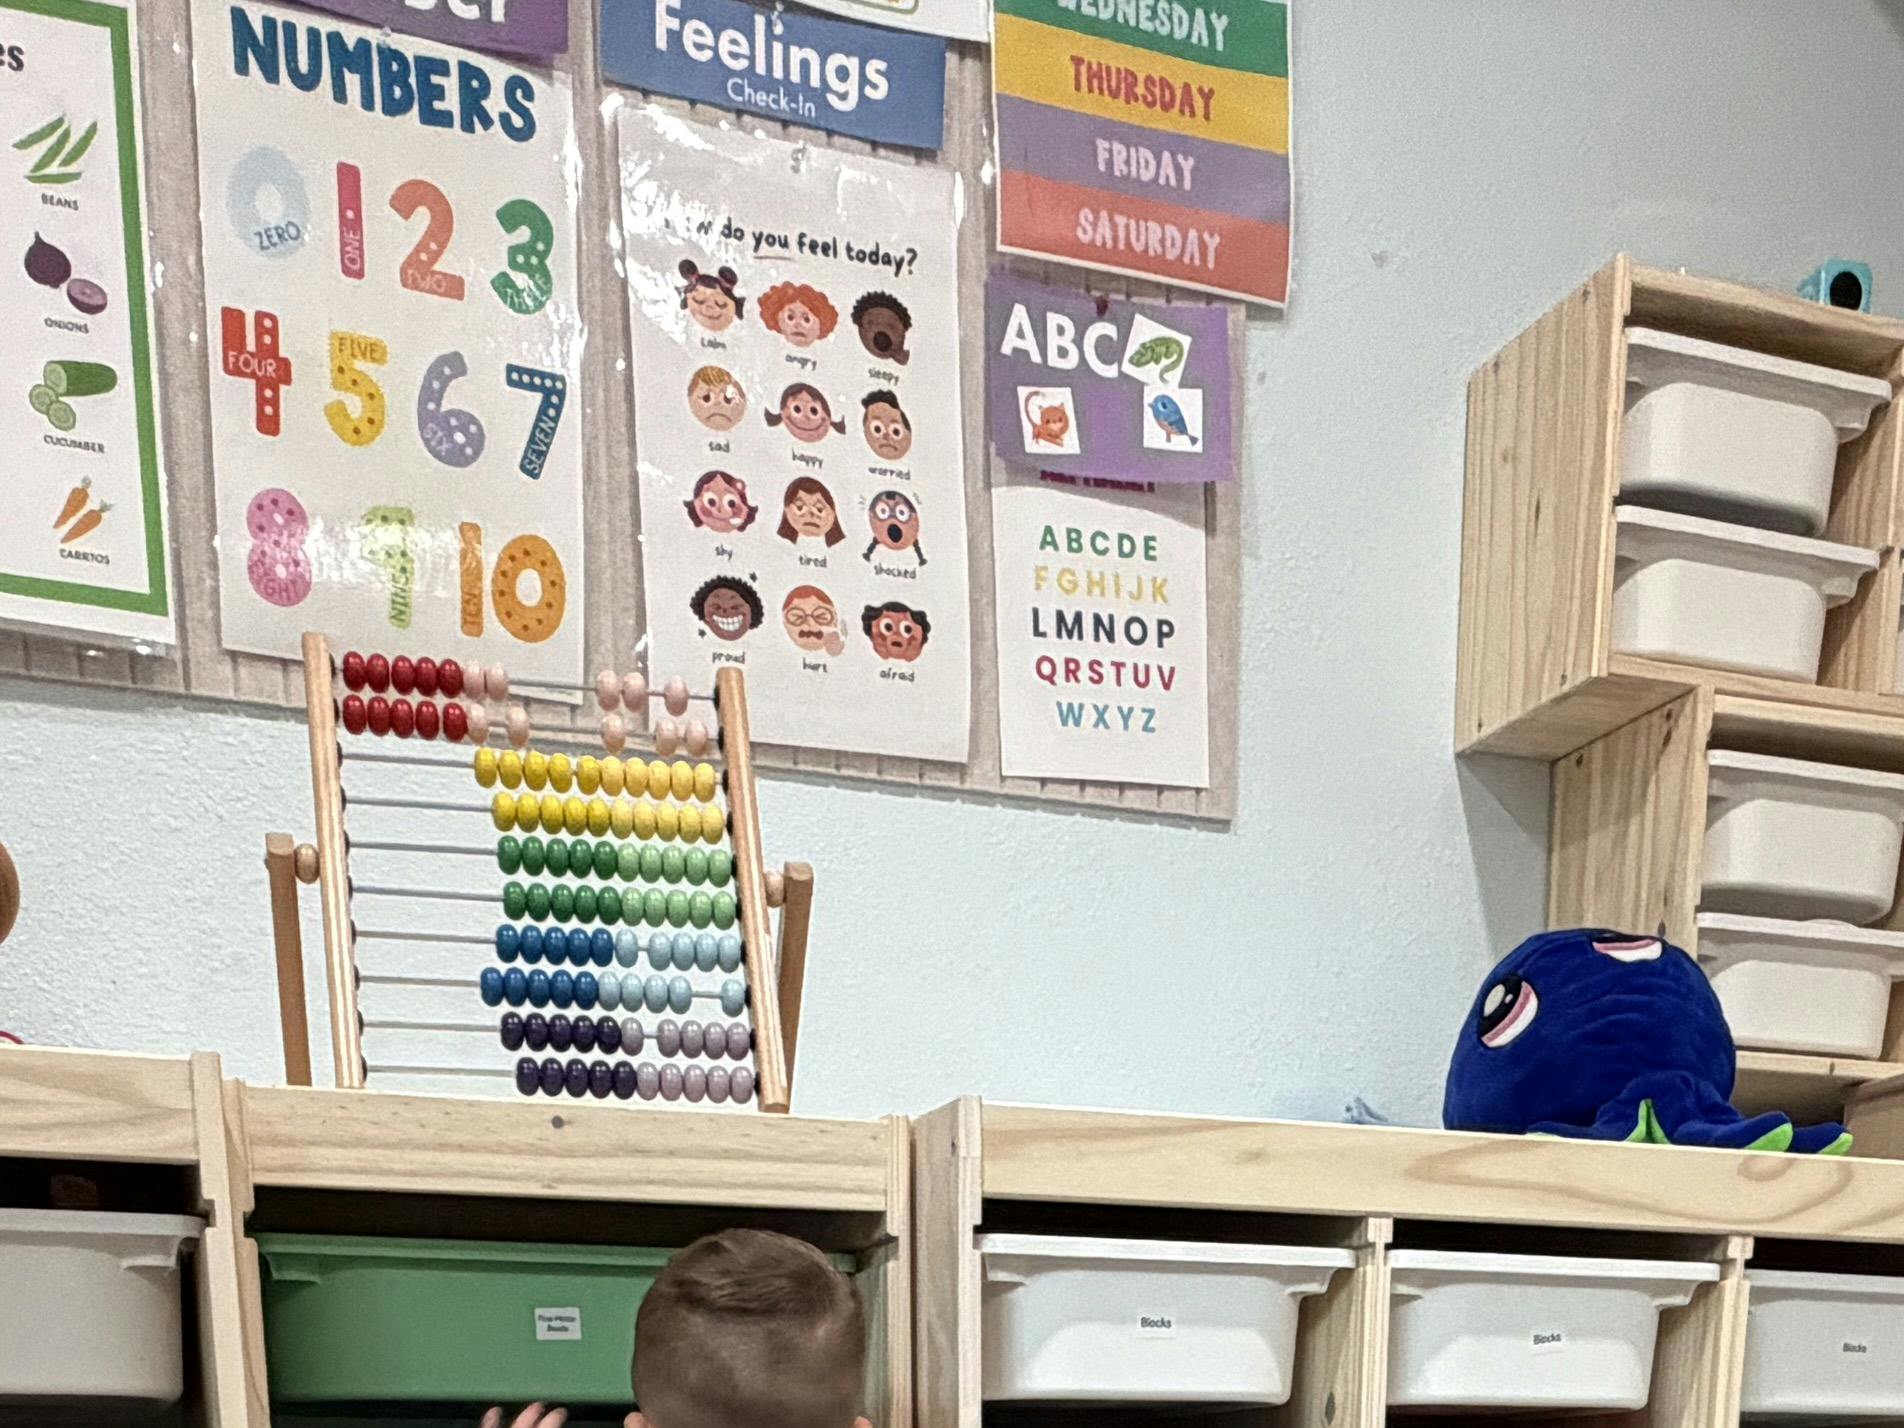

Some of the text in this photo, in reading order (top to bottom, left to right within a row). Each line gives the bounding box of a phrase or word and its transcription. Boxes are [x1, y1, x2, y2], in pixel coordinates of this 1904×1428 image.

[655, 0, 889, 112] Feelings
[1057, 0, 1229, 51] DNESDAY
[230, 6, 538, 143] NUMBERS
[727, 78, 816, 119] Check-In
[1070, 55, 1215, 121] THURSDAY
[1095, 137, 1194, 191] FRIDAY
[41, 192, 79, 211] BEANS
[254, 220, 301, 251] ZERO
[345, 228, 361, 271] ONE
[389, 179, 465, 301] 2
[490, 199, 554, 314] 3
[751, 229, 790, 254] you
[797, 232, 838, 259] feel
[845, 245, 918, 278] today?
[1076, 207, 1220, 271] SATURDAY
[227, 351, 278, 378] FOUR
[338, 337, 380, 361] FIVE
[1000, 303, 1119, 378] ABC
[221, 307, 292, 437] 4
[324, 330, 389, 446] 5
[417, 351, 485, 468] 6
[506, 363, 567, 480] 7
[44, 434, 105, 454] CUCUMBER
[524, 414, 557, 474] SEVEN
[247, 488, 313, 607] 8
[459, 522, 568, 643] 10
[1141, 1316, 1176, 1328] Blocks
[1533, 1333, 1561, 1345] Blocks
